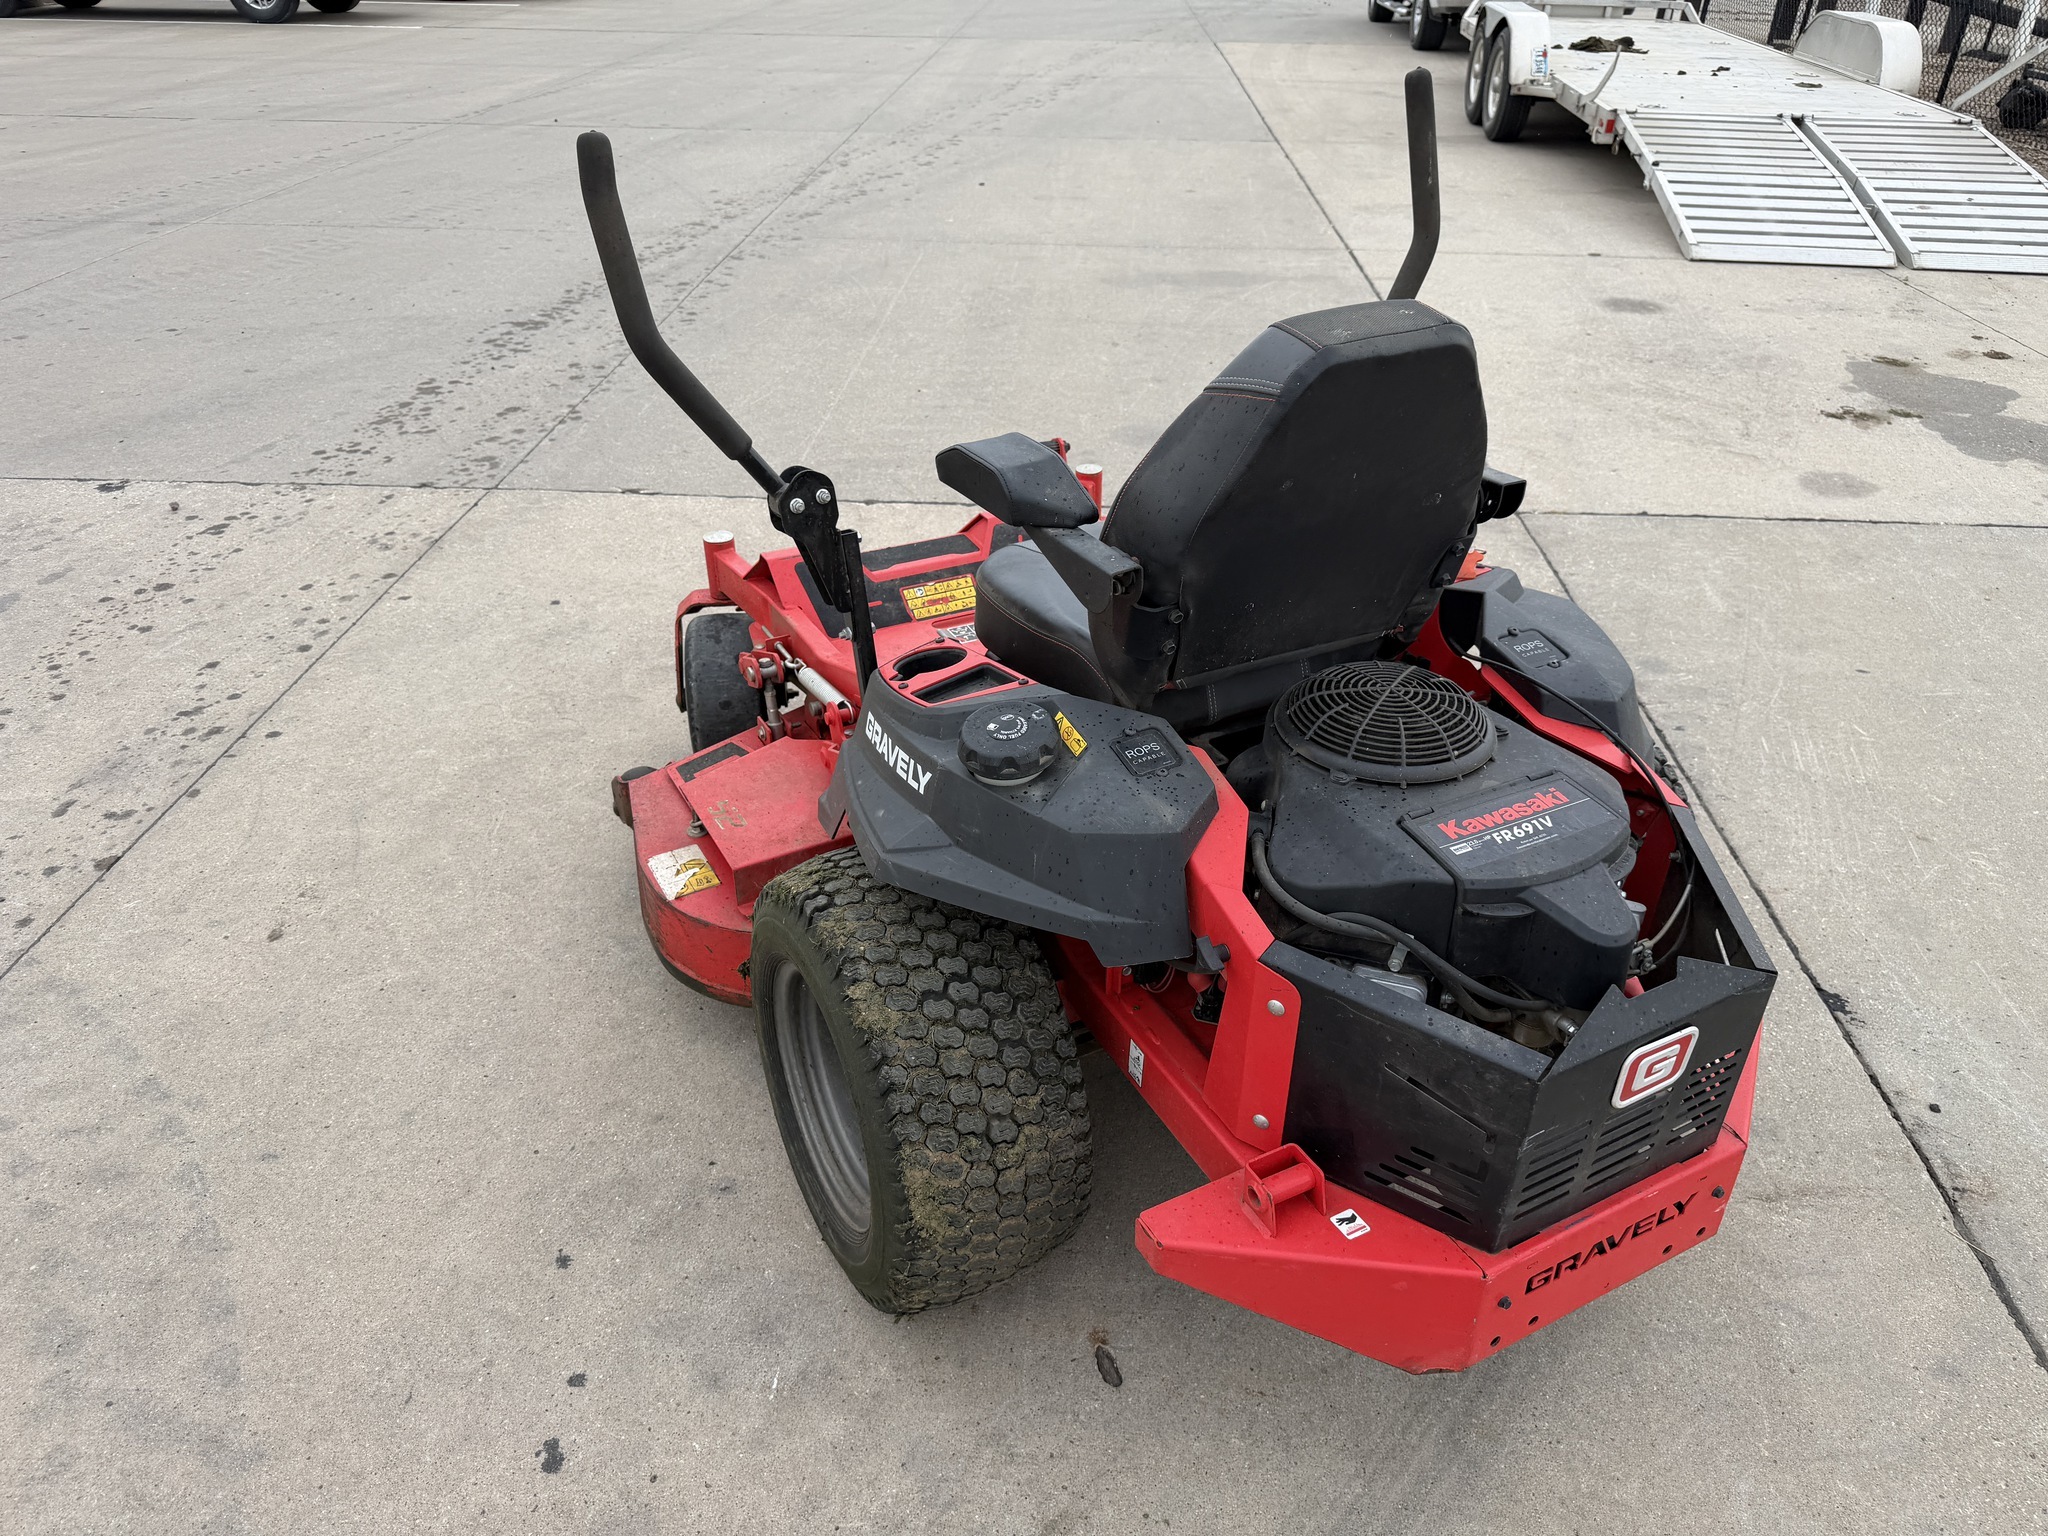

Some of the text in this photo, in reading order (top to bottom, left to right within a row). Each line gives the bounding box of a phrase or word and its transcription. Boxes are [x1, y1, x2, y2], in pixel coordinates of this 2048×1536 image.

[1513, 640, 1544, 653] ROPS
[1521, 647, 1550, 658] CAPABLE
[993, 732, 1007, 740] ONLY
[865, 711, 932, 795] GRAVELY
[1125, 742, 1161, 759] ROPS
[1132, 751, 1167, 765] CAPABLE
[1437, 787, 1570, 840] Kawasaki
[1491, 815, 1553, 844] FR691V
[1525, 1193, 1698, 1294] GRAVELY
